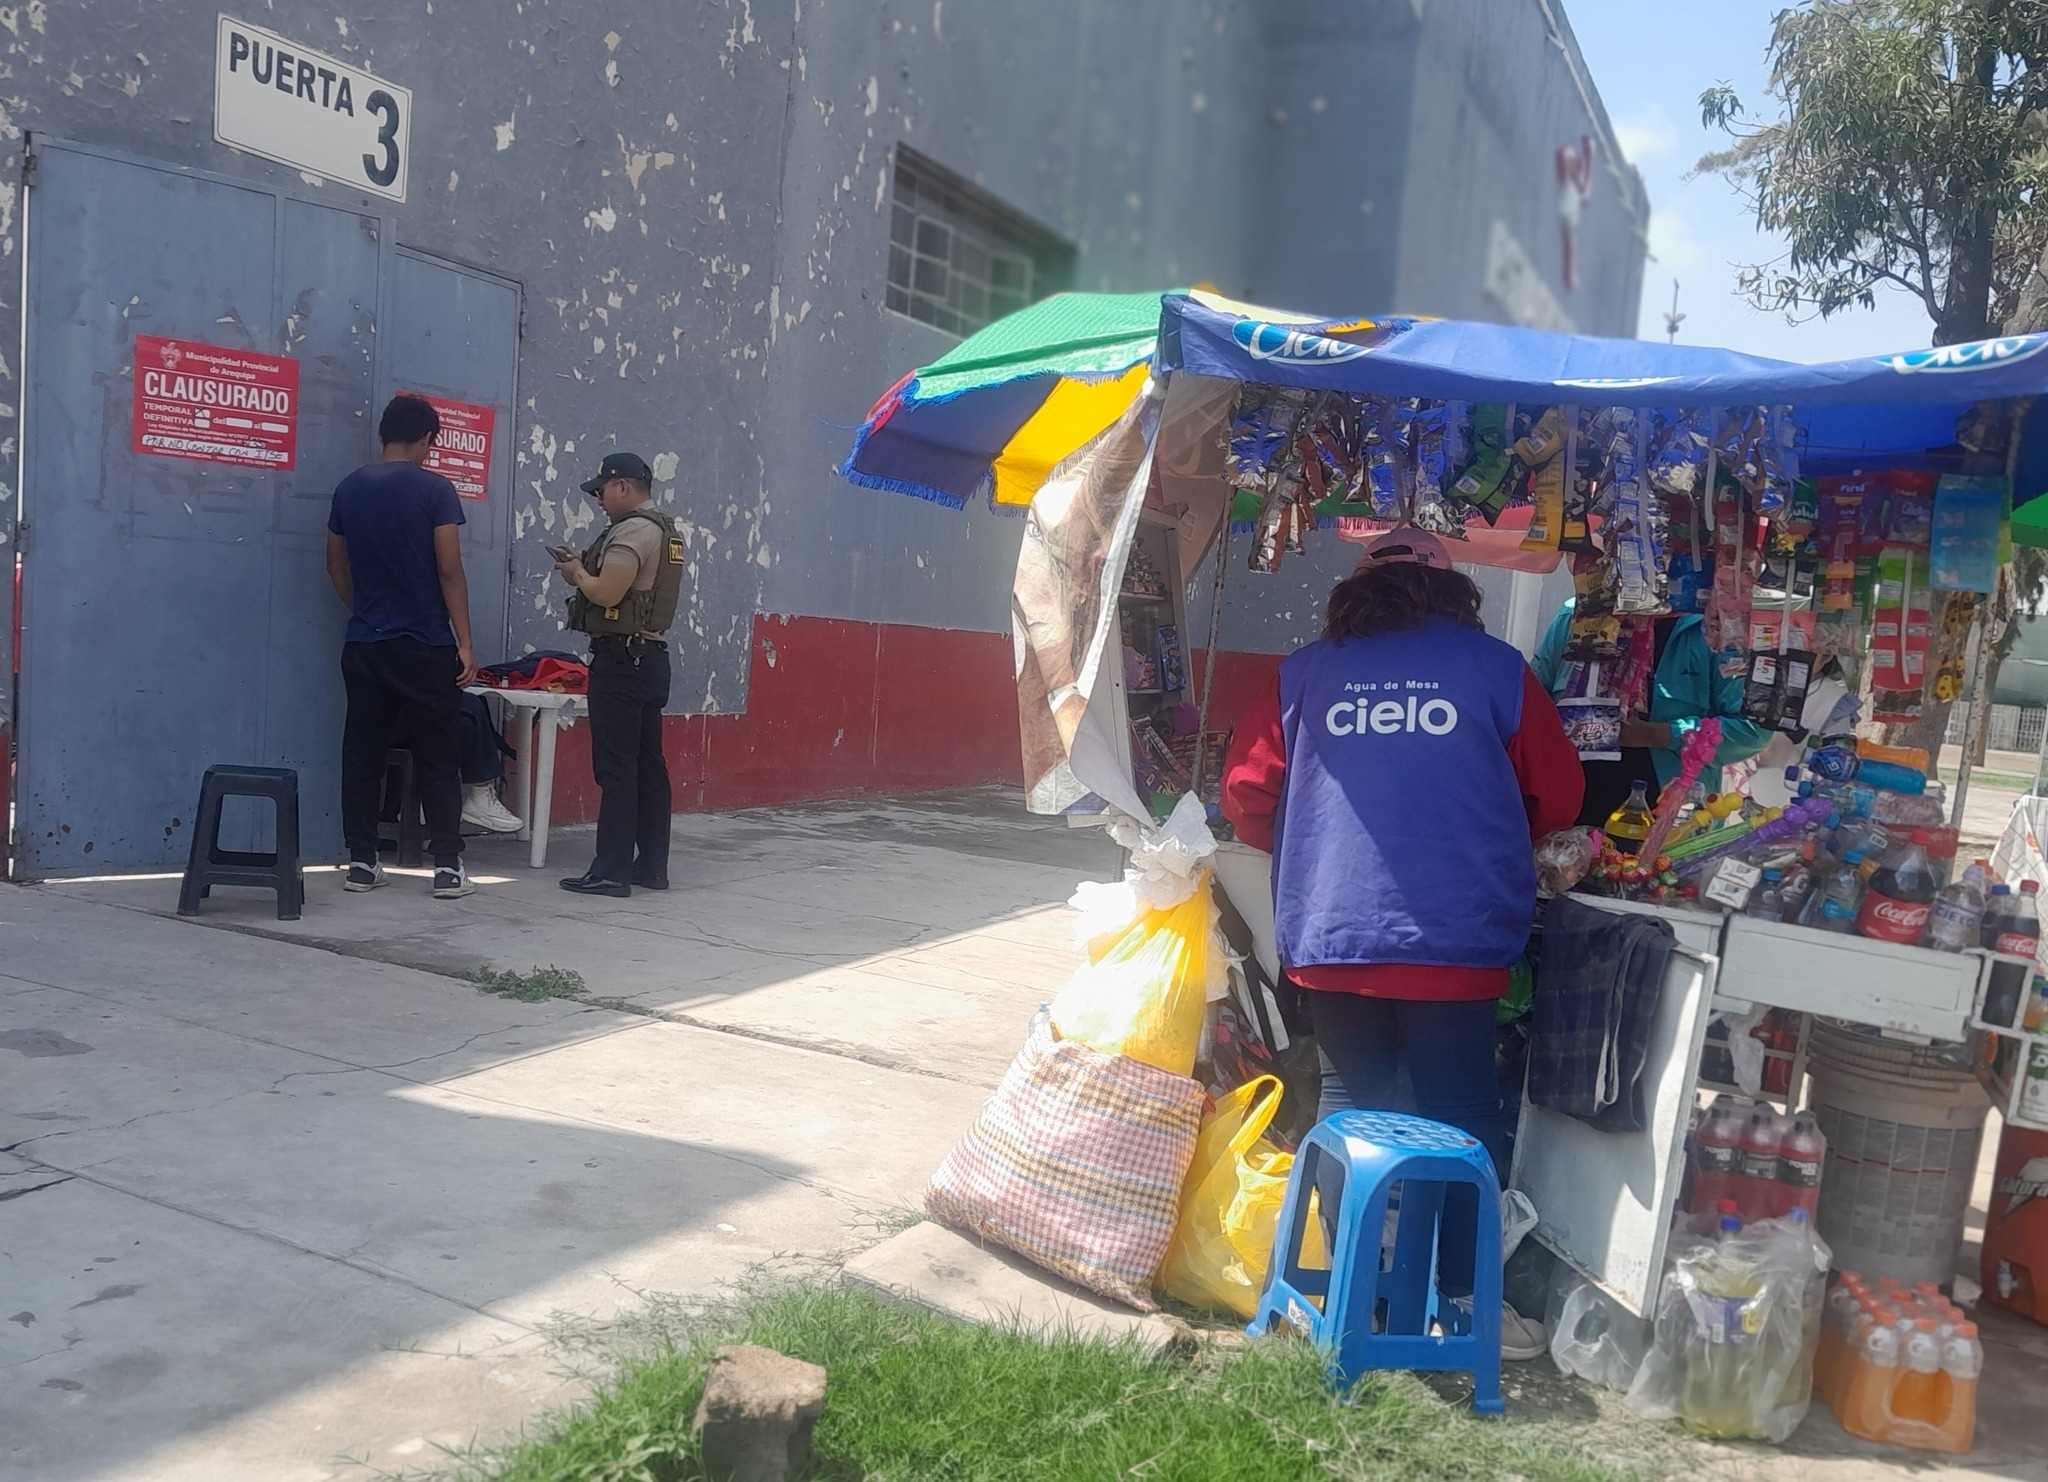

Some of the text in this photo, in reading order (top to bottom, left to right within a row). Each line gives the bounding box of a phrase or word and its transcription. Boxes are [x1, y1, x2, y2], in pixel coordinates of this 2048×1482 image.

[230, 31, 400, 187] PUERTA 3
[186, 351, 279, 373] Municipalidad Provincial
[209, 366, 256, 380] de Arequipa
[144, 371, 290, 414] CLAUSURADO
[143, 402, 192, 416] TEMPORAL
[143, 412, 194, 426] DEFINITIVA
[435, 428, 486, 454] SURADO
[1344, 680, 1439, 693] Agua de Mesa
[1326, 696, 1458, 736] cielo
[1935, 906, 1975, 927] CIELO
